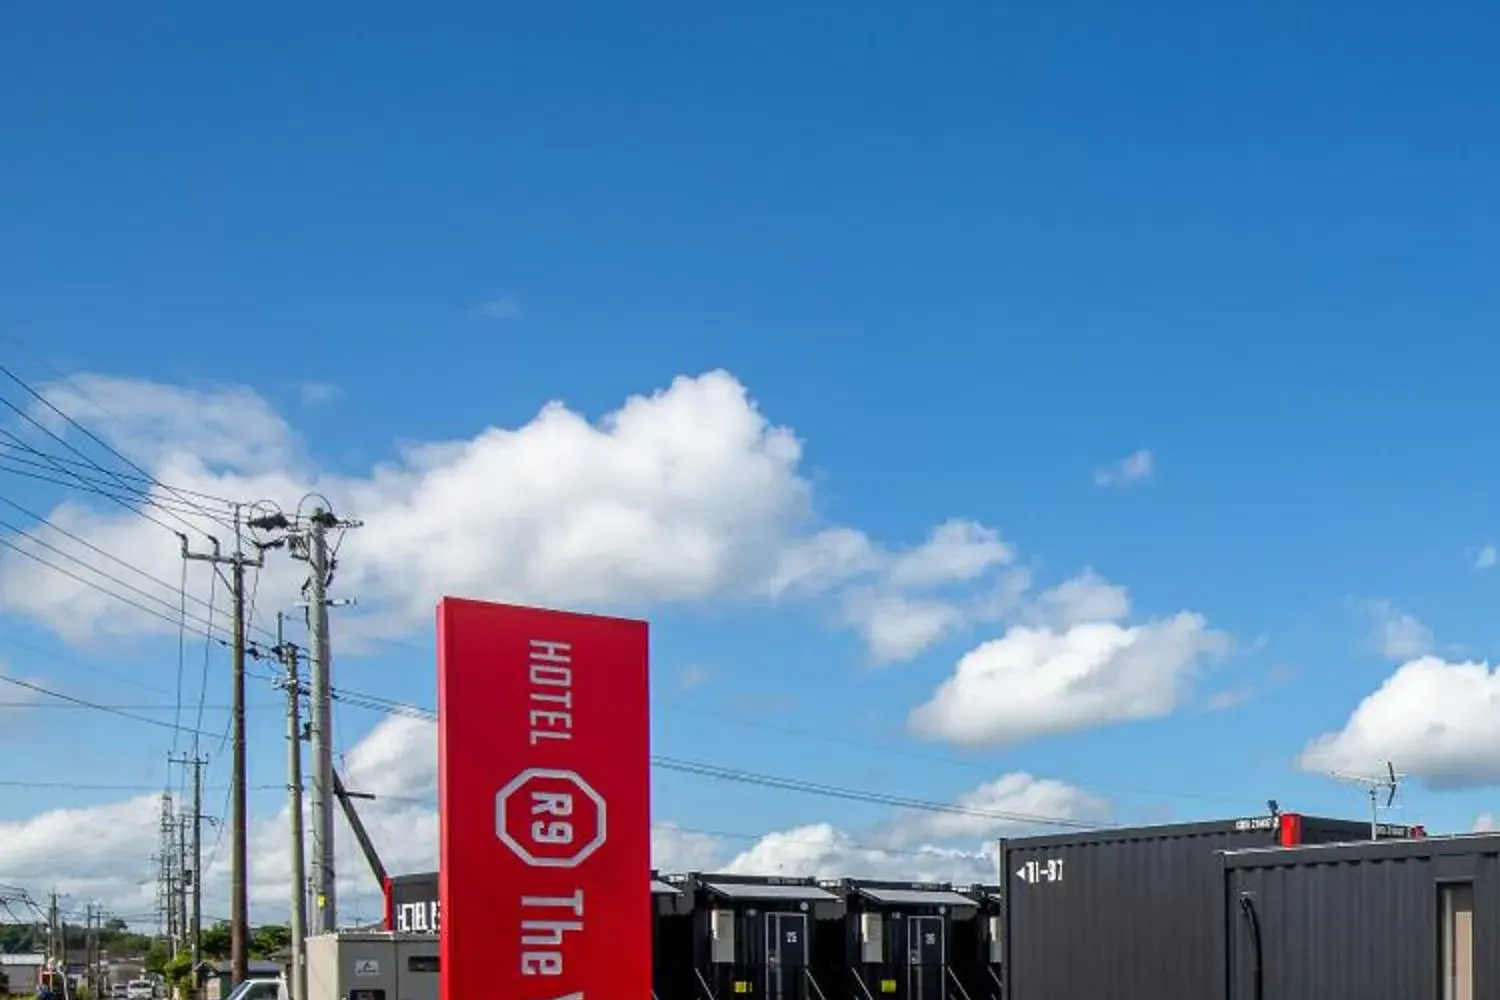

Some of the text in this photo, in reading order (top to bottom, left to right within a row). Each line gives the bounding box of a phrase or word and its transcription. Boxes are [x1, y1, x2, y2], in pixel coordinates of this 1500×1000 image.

[529, 639, 573, 745] HOTEL
[531, 791, 574, 845] R9
[521, 889, 584, 976] The
